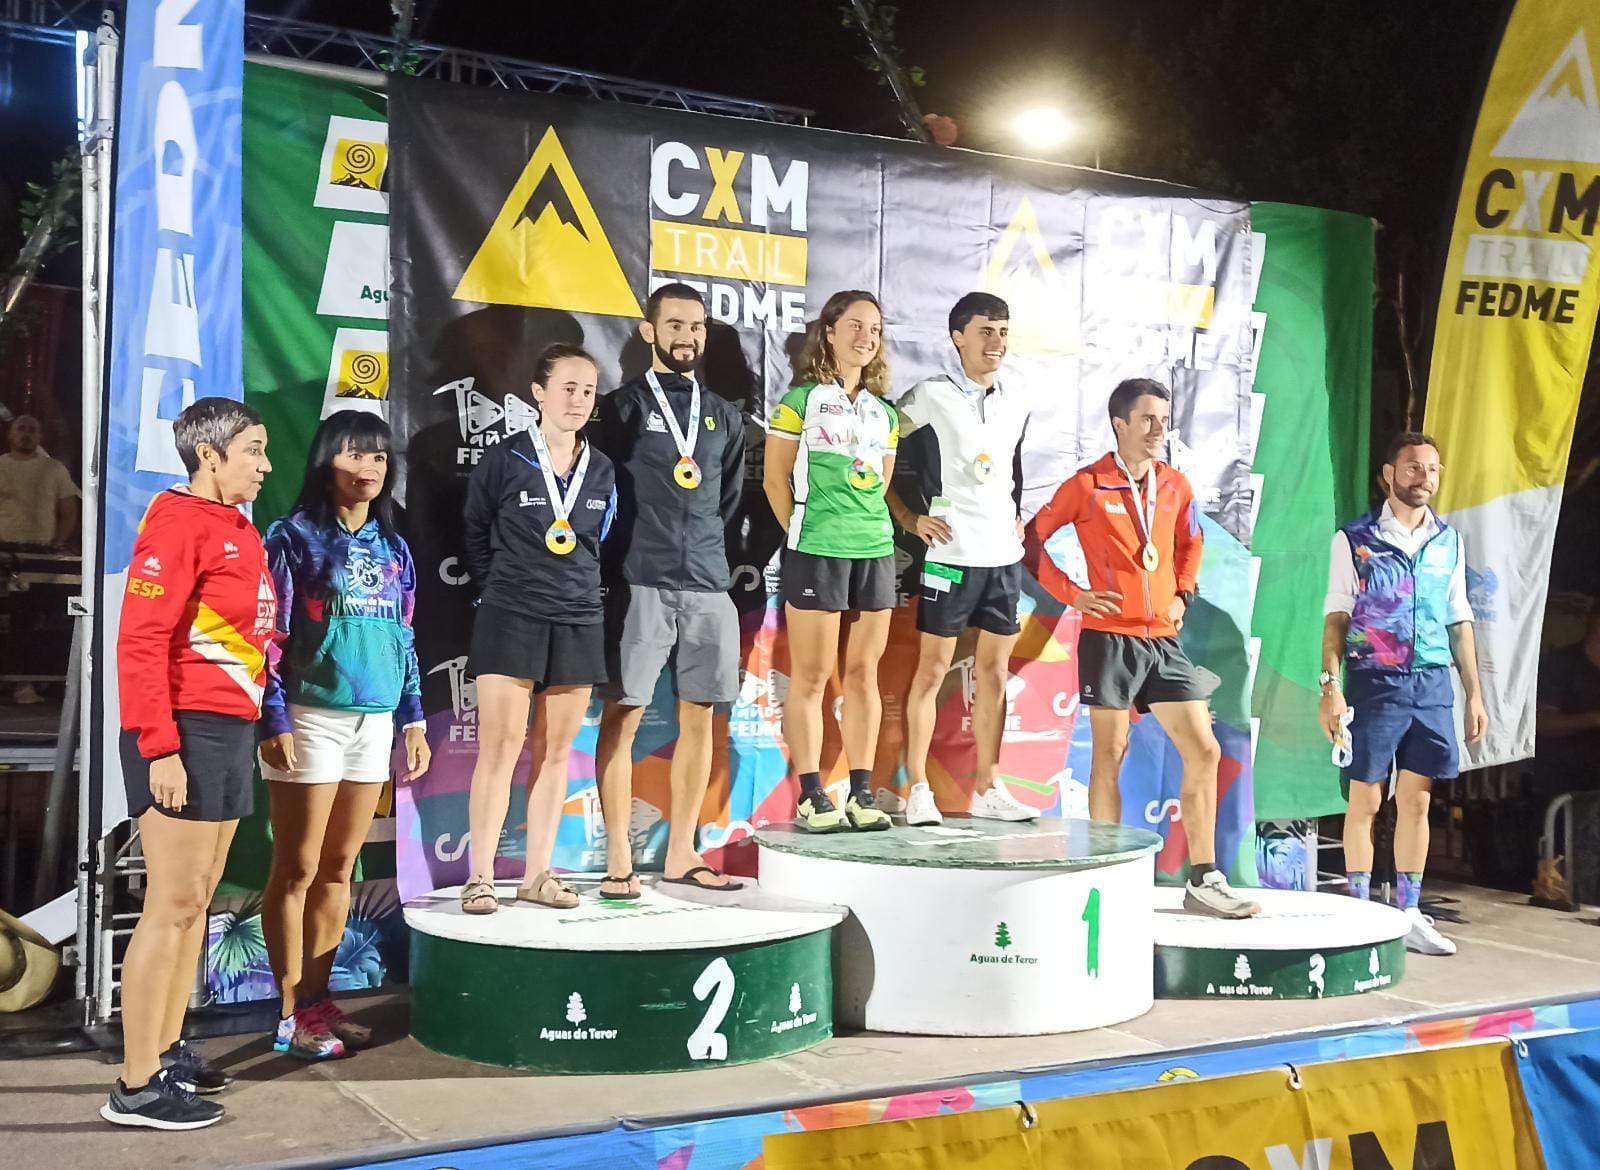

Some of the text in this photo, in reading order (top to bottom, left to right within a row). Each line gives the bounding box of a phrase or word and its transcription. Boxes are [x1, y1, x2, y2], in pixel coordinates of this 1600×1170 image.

[650, 141, 808, 232] CXM
[1475, 168, 1600, 236] CXM
[664, 227, 794, 280] TRAIL
[650, 276, 807, 334] DME
[1455, 280, 1580, 324] FEDME
[128, 577, 165, 599] ESP
[1081, 887, 1100, 979] 1
[970, 953, 1039, 965] Aguas de Teror
[1308, 953, 1326, 999] 3
[687, 956, 735, 1061] 2
[1206, 982, 1235, 996] Auas
[540, 1027, 618, 1041] Aguas de Teror
